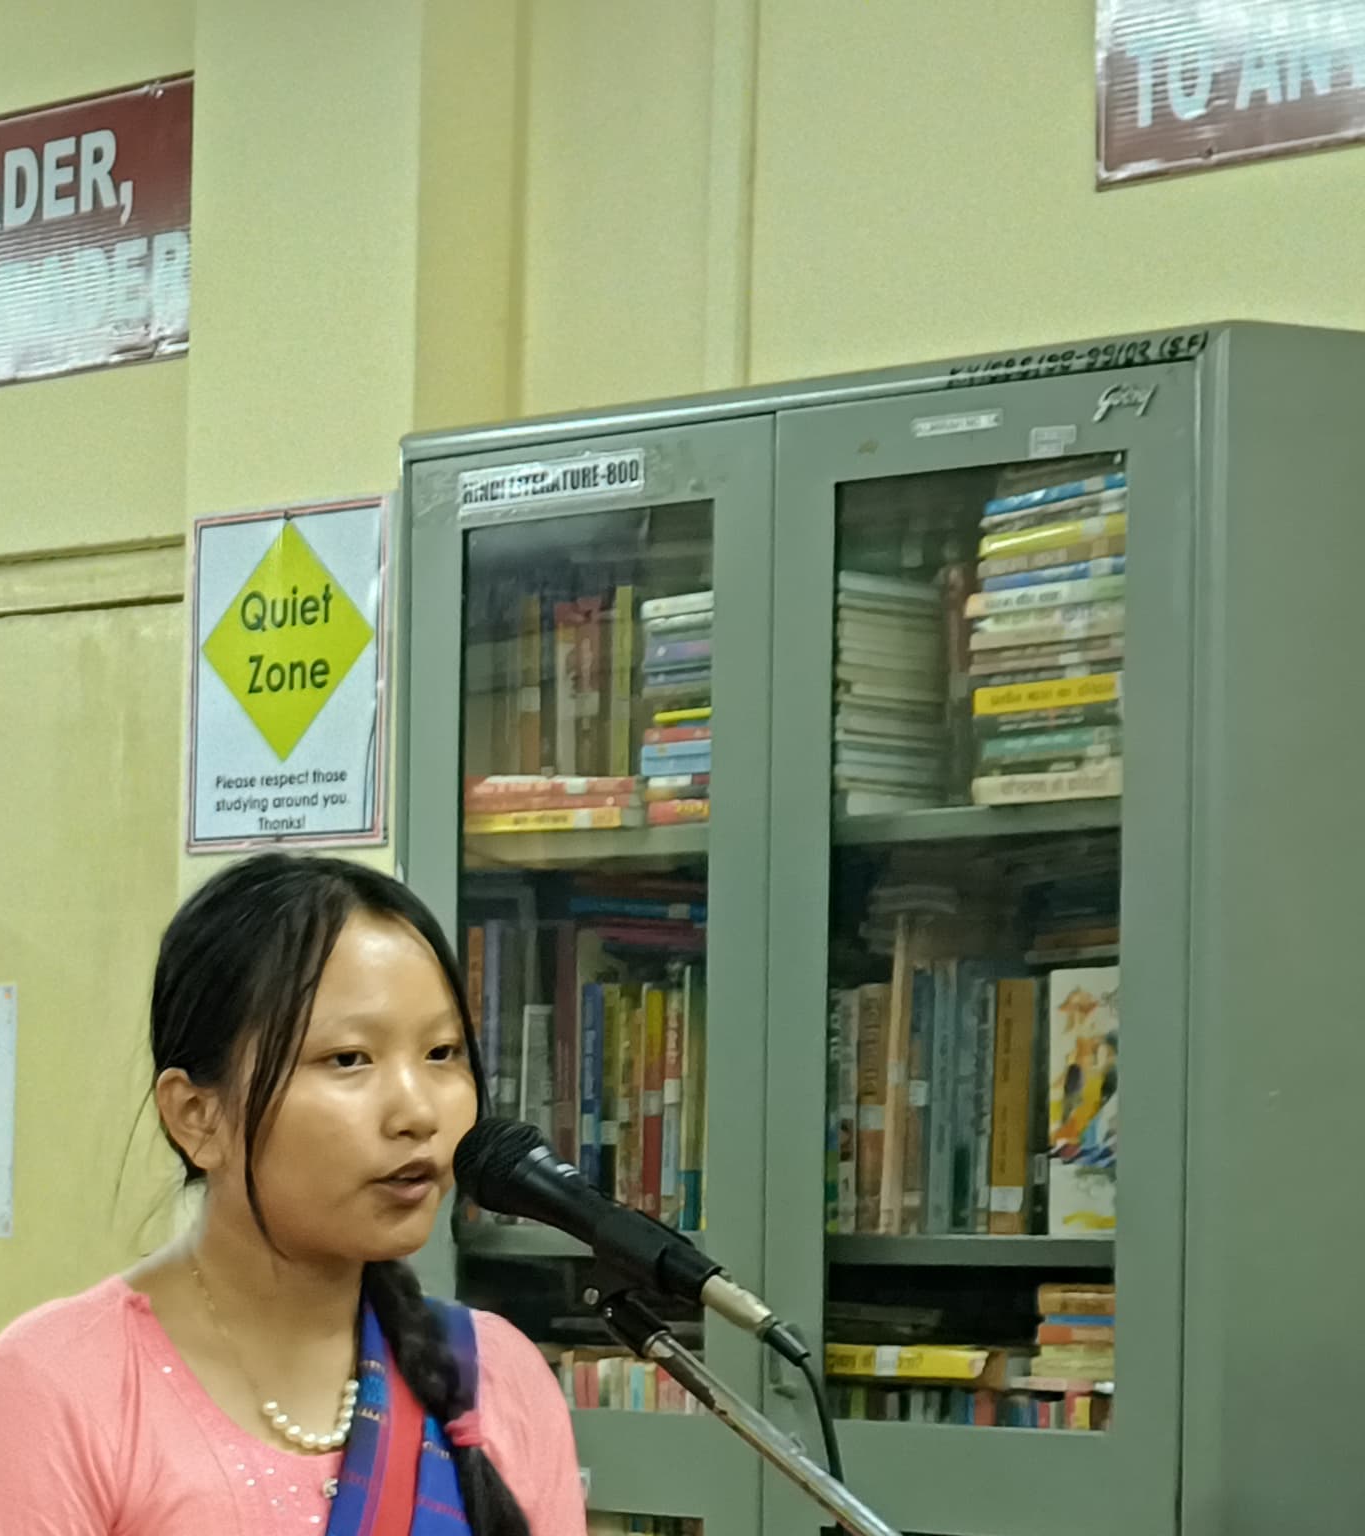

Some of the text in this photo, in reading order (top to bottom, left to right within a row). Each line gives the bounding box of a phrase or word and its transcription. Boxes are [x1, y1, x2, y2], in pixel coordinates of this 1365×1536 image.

[240, 583, 334, 633] Quiet
[247, 654, 331, 695] Zone
[215, 769, 348, 789] Please respect those
[215, 796, 269, 812] studying
[272, 793, 319, 808] around
[258, 814, 306, 831] Thanks!
